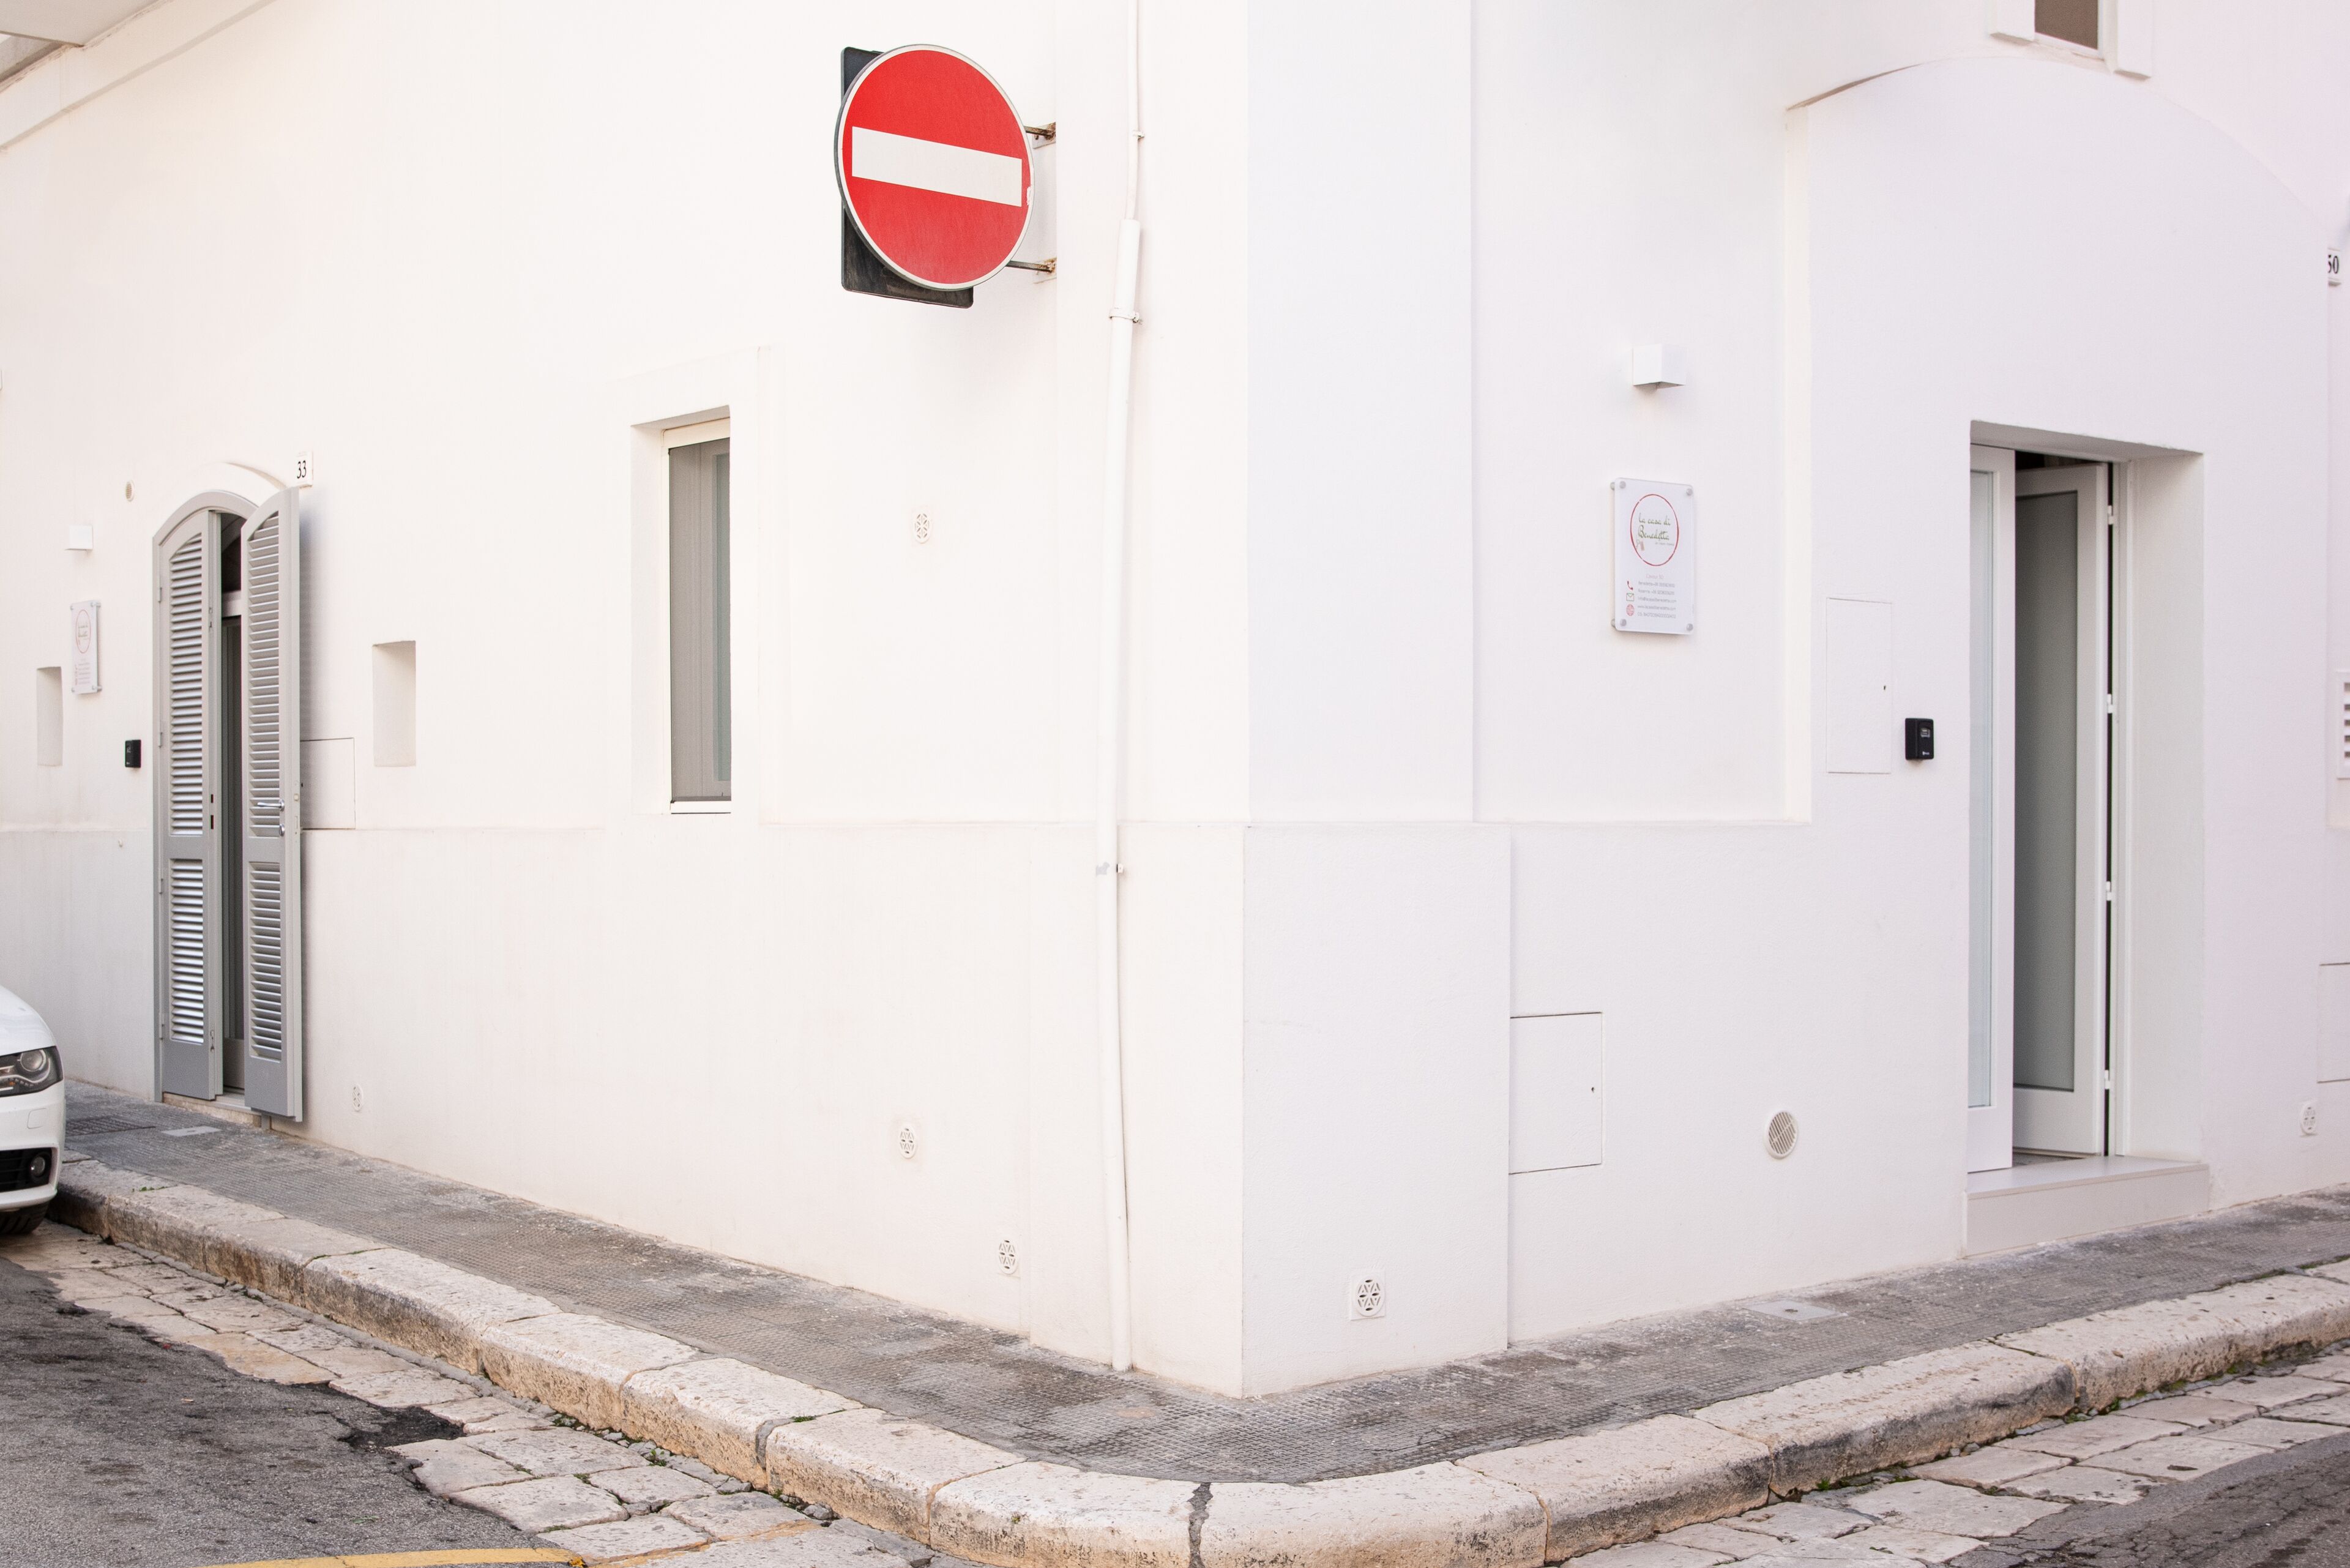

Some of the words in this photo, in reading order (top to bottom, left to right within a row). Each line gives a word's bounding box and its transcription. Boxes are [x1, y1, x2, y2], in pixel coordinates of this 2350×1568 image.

[297, 460, 307, 479] 33
[1663, 515, 1671, 526] di
[1638, 525, 1669, 541] Benedetta
